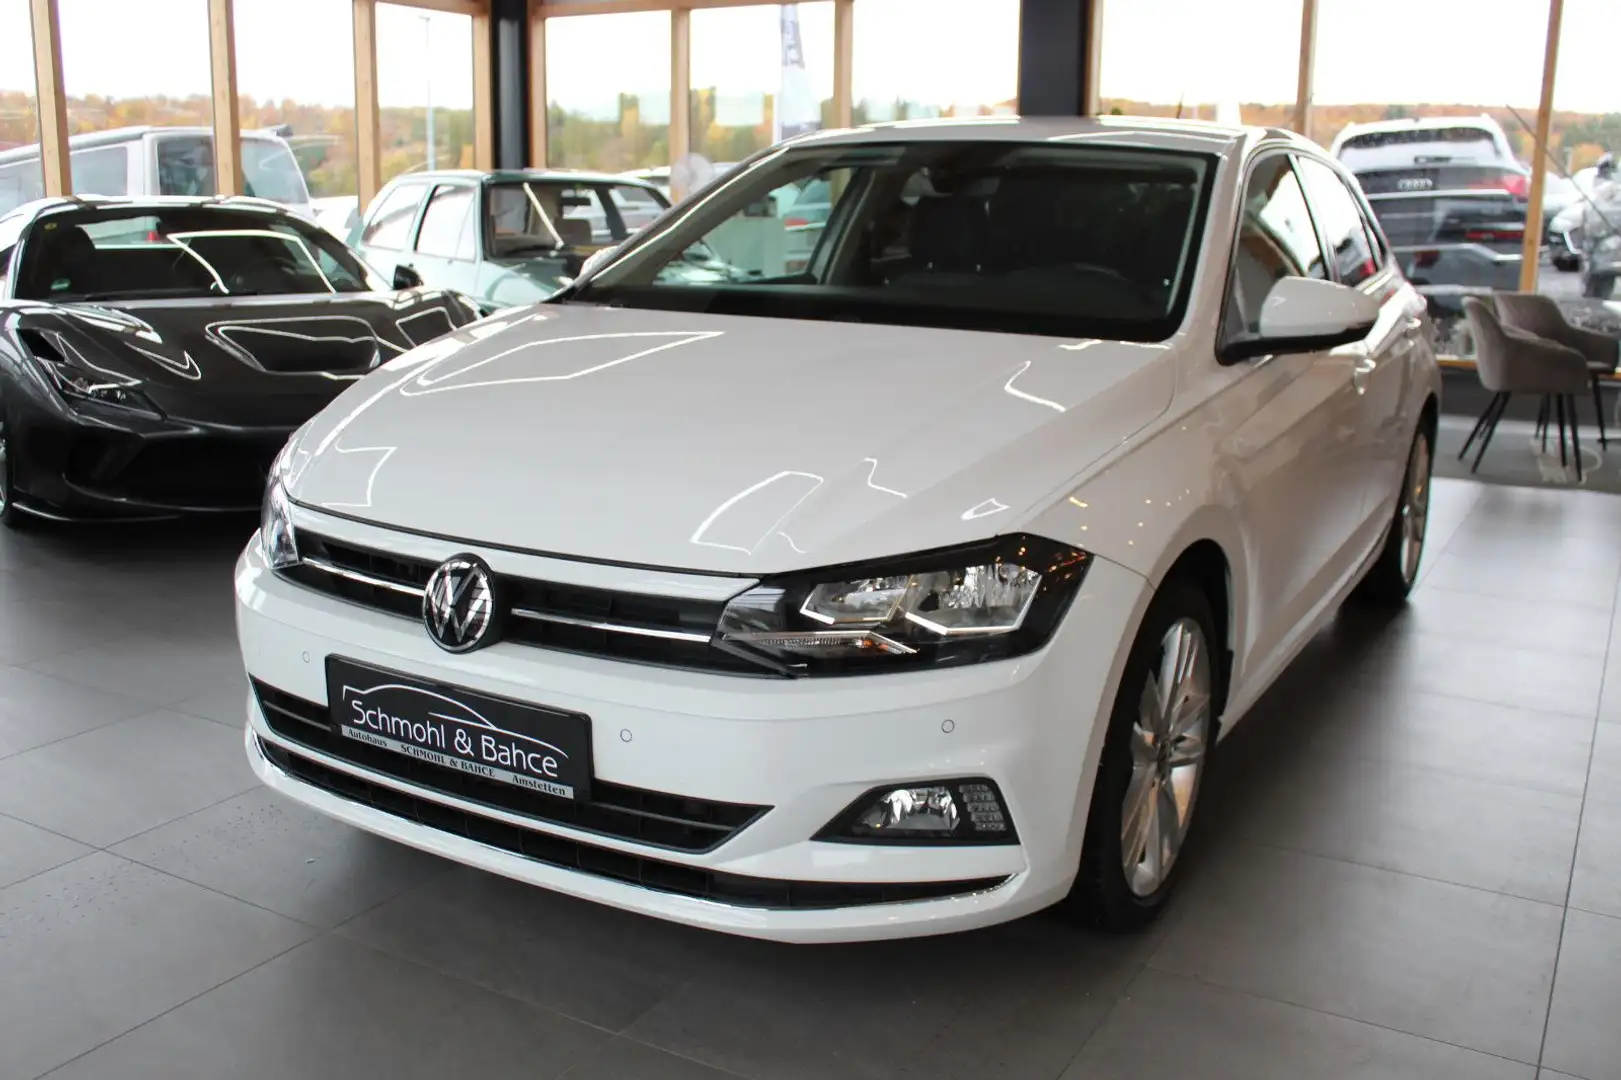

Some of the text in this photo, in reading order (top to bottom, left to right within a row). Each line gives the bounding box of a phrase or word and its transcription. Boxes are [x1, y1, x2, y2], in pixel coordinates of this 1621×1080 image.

[347, 728, 567, 796] Autohaus SCHMOHL & BAHCE Amstetten
[351, 699, 558, 778] Schmohl & Bahce
